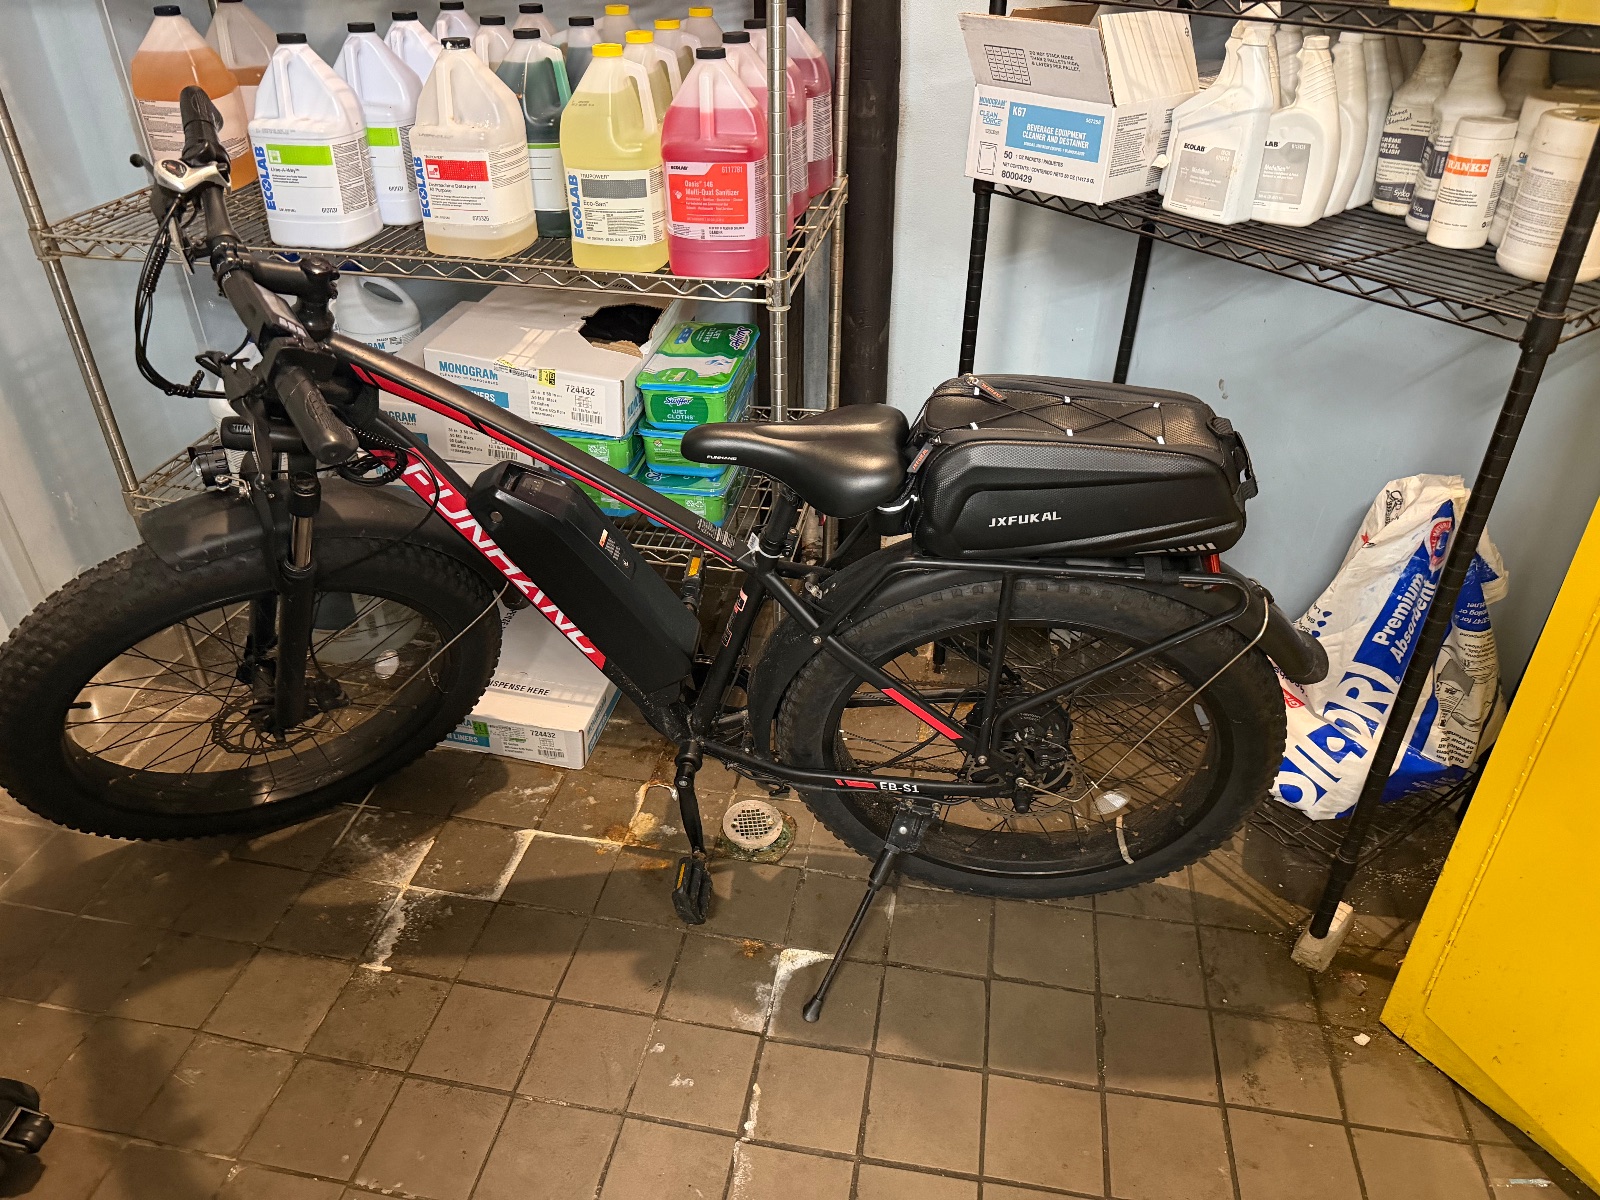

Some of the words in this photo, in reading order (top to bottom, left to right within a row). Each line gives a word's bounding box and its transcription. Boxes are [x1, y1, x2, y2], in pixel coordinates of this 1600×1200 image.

[1012, 105, 1027, 118] K67
[1026, 123, 1055, 135] BEVERAGE
[1055, 127, 1087, 140] EQUIPMENT
[1022, 131, 1047, 142] CLEANER
[1047, 134, 1059, 144] AND
[1059, 136, 1090, 149] DESTAINER
[1183, 142, 1206, 153] ECOLAB
[1003, 150, 1013, 160] 50
[1447, 159, 1489, 173] RANKE
[255, 146, 277, 211] ECOLAB
[1001, 169, 1033, 183] 8000429
[413, 156, 432, 218] ECOLAB
[568, 174, 585, 239] ECOLAB
[438, 360, 499, 381] MONOGRAM
[565, 384, 596, 397] 724432
[664, 395, 694, 407] Swiffer
[988, 510, 1062, 528] JXFUKAL
[1372, 572, 1425, 646] Premium
[1389, 579, 1438, 664] Absorbent
[526, 685, 551, 696] HERE
[453, 731, 479, 744] LINERS
[529, 728, 556, 739] 724432
[878, 781, 920, 794] EB-S1
